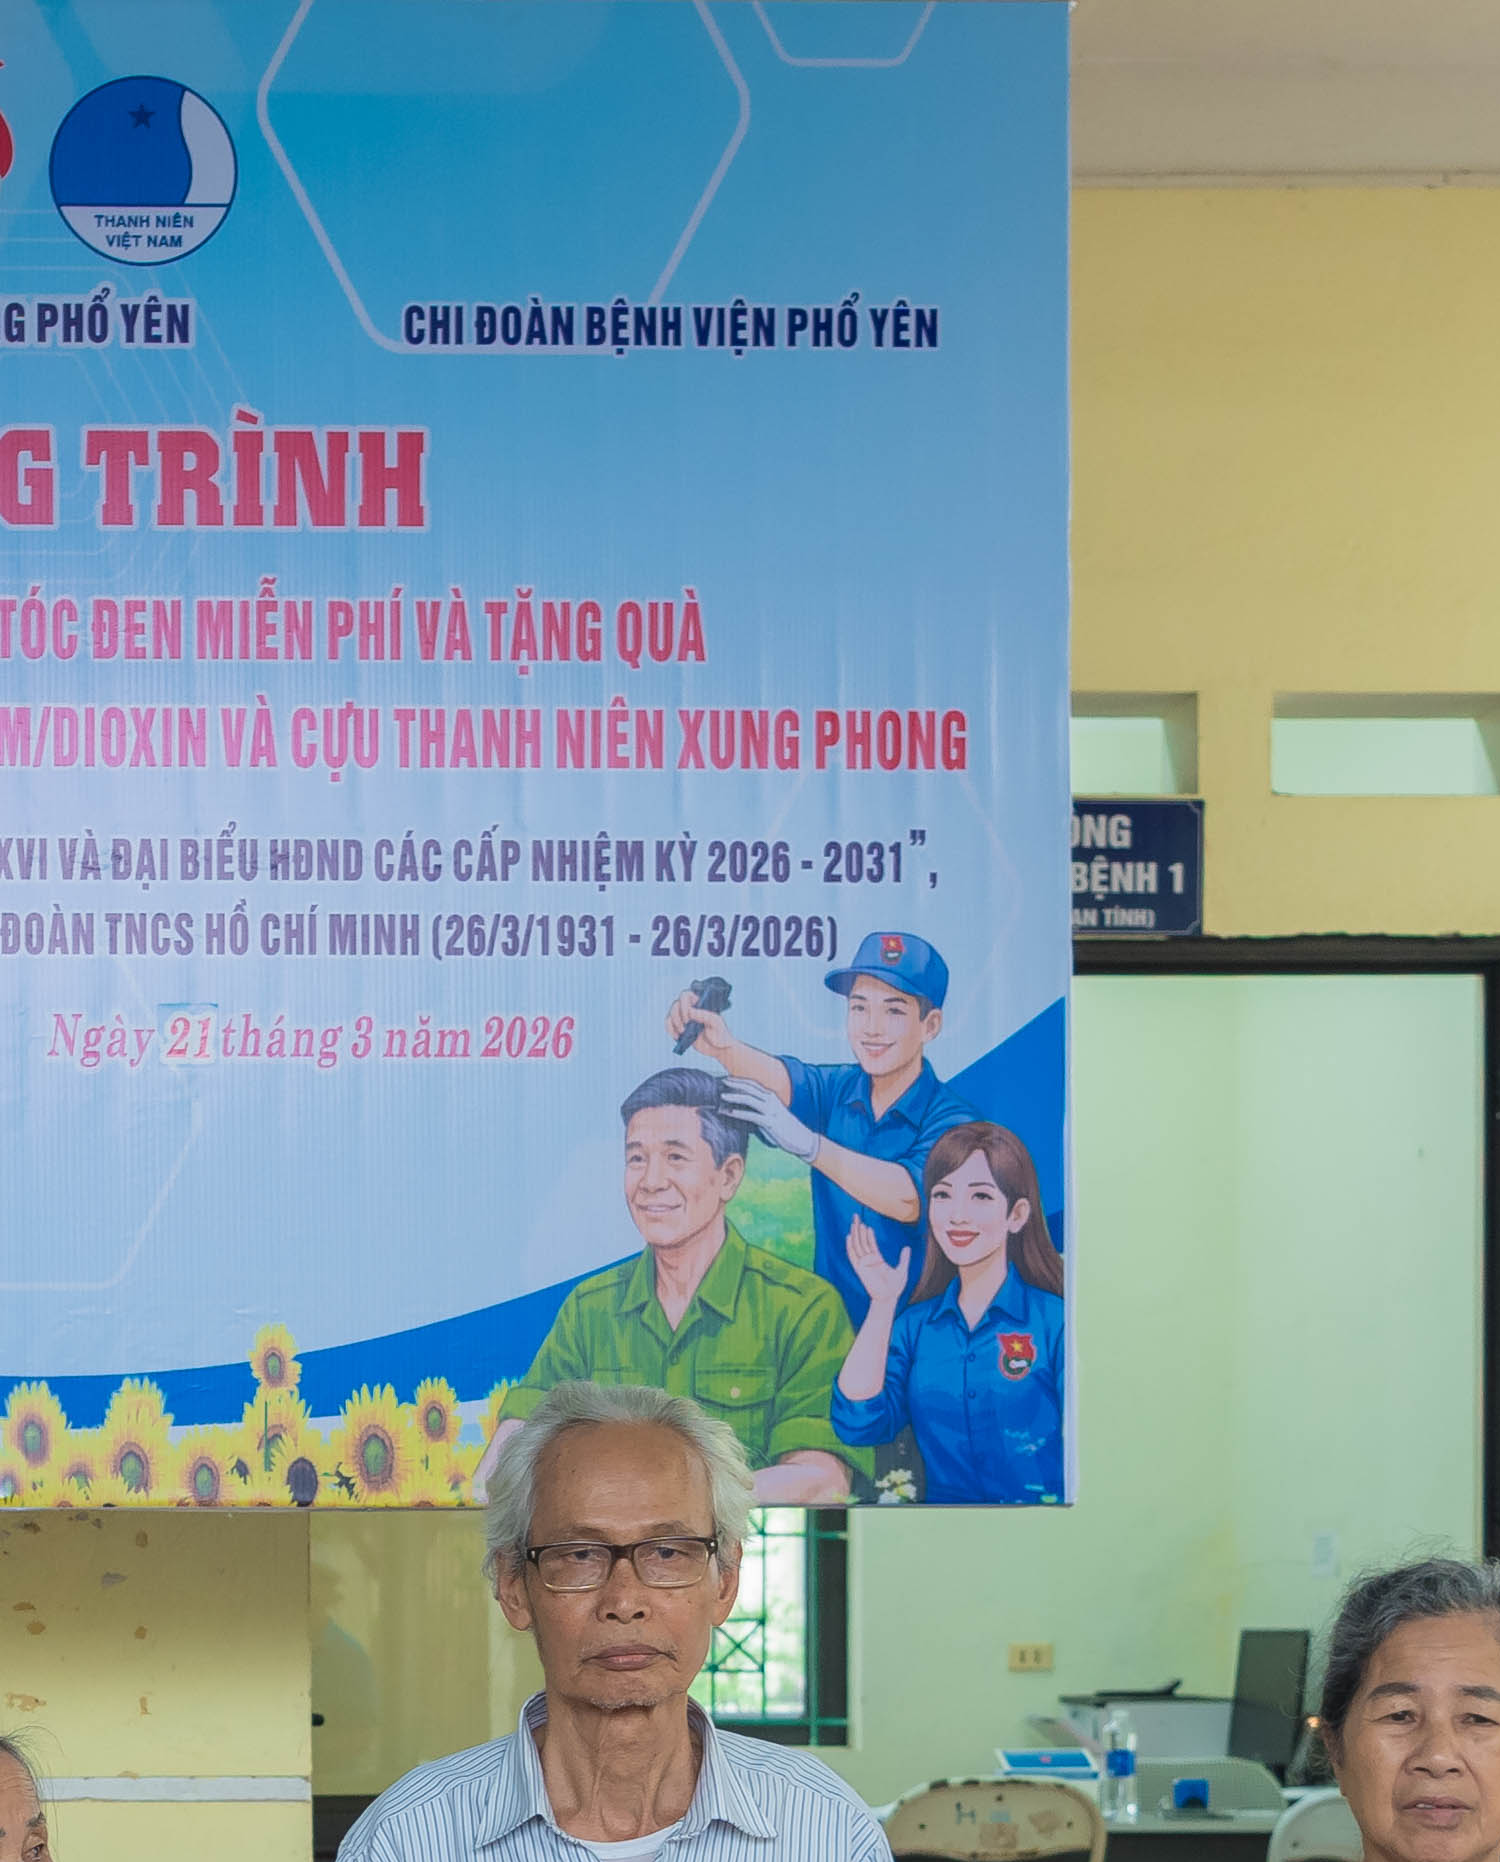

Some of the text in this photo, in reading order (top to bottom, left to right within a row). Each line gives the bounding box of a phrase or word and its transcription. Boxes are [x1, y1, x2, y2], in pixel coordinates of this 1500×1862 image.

[95, 214, 194, 228] THANH NIÊN
[106, 234, 182, 251] VIỆT NAM
[37, 286, 112, 343] PHỔ
[120, 293, 190, 343] YÊN
[404, 293, 938, 356] CHI ĐOÀN BỆNH VIỆN PHỔ YÊN
[86, 408, 426, 528] TRÌNH
[91, 599, 181, 660] ĐEN
[197, 577, 312, 662] MIỄN
[328, 585, 404, 662] PHÍ
[416, 589, 473, 662] VÀ
[486, 586, 602, 674] TẶNG
[617, 587, 705, 668] QUÀ
[219, 696, 277, 768] VÀ
[291, 704, 381, 782] CỰU
[394, 709, 542, 770] THANH
[556, 698, 667, 770] NIÊN
[679, 711, 800, 770] XUNG
[815, 711, 967, 772] PHONG
[57, 826, 101, 881] VÀ
[112, 837, 168, 891] ĐẠI
[180, 820, 259, 881] BIỂU
[270, 837, 363, 881] HĐND
[373, 826, 442, 881] CÁC
[452, 822, 521, 883] CẤP
[531, 832, 644, 893] NHIỆM
[655, 828, 698, 883] KỲ
[708, 840, 790, 883] 2026
[1073, 855, 1184, 900] BỆNH 1
[0, 904, 93, 957] ĐOÀN
[103, 914, 194, 955] TNCS
[205, 897, 250, 957] HỒ
[260, 904, 318, 957] CHÍ
[328, 914, 420, 957] MINH
[431, 914, 617, 960] (26/3/1931
[651, 914, 838, 962] 26/3/2026)
[1102, 905, 1156, 928] TÍNH)
[46, 1011, 573, 1067] Ngày 21 tháng 3 năm 2026
